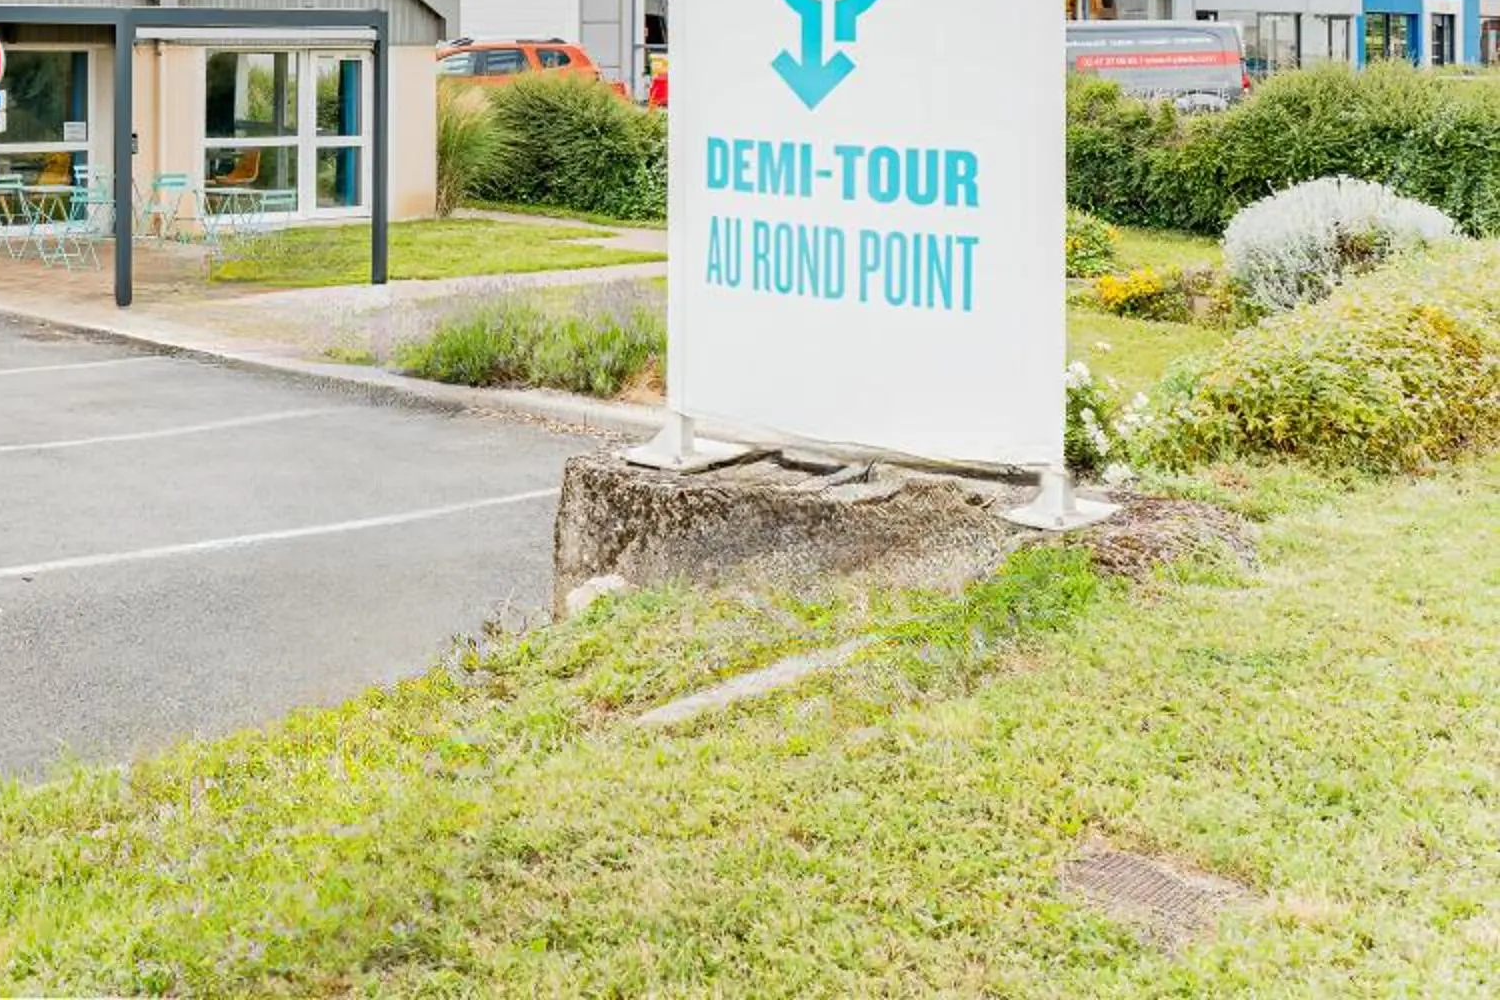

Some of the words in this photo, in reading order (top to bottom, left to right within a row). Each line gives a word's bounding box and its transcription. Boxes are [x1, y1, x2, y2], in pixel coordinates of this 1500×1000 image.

[706, 136, 979, 207] DEMI-TOUR
[706, 215, 741, 288] AU
[753, 220, 845, 299] ROND
[859, 229, 979, 312] POINT
